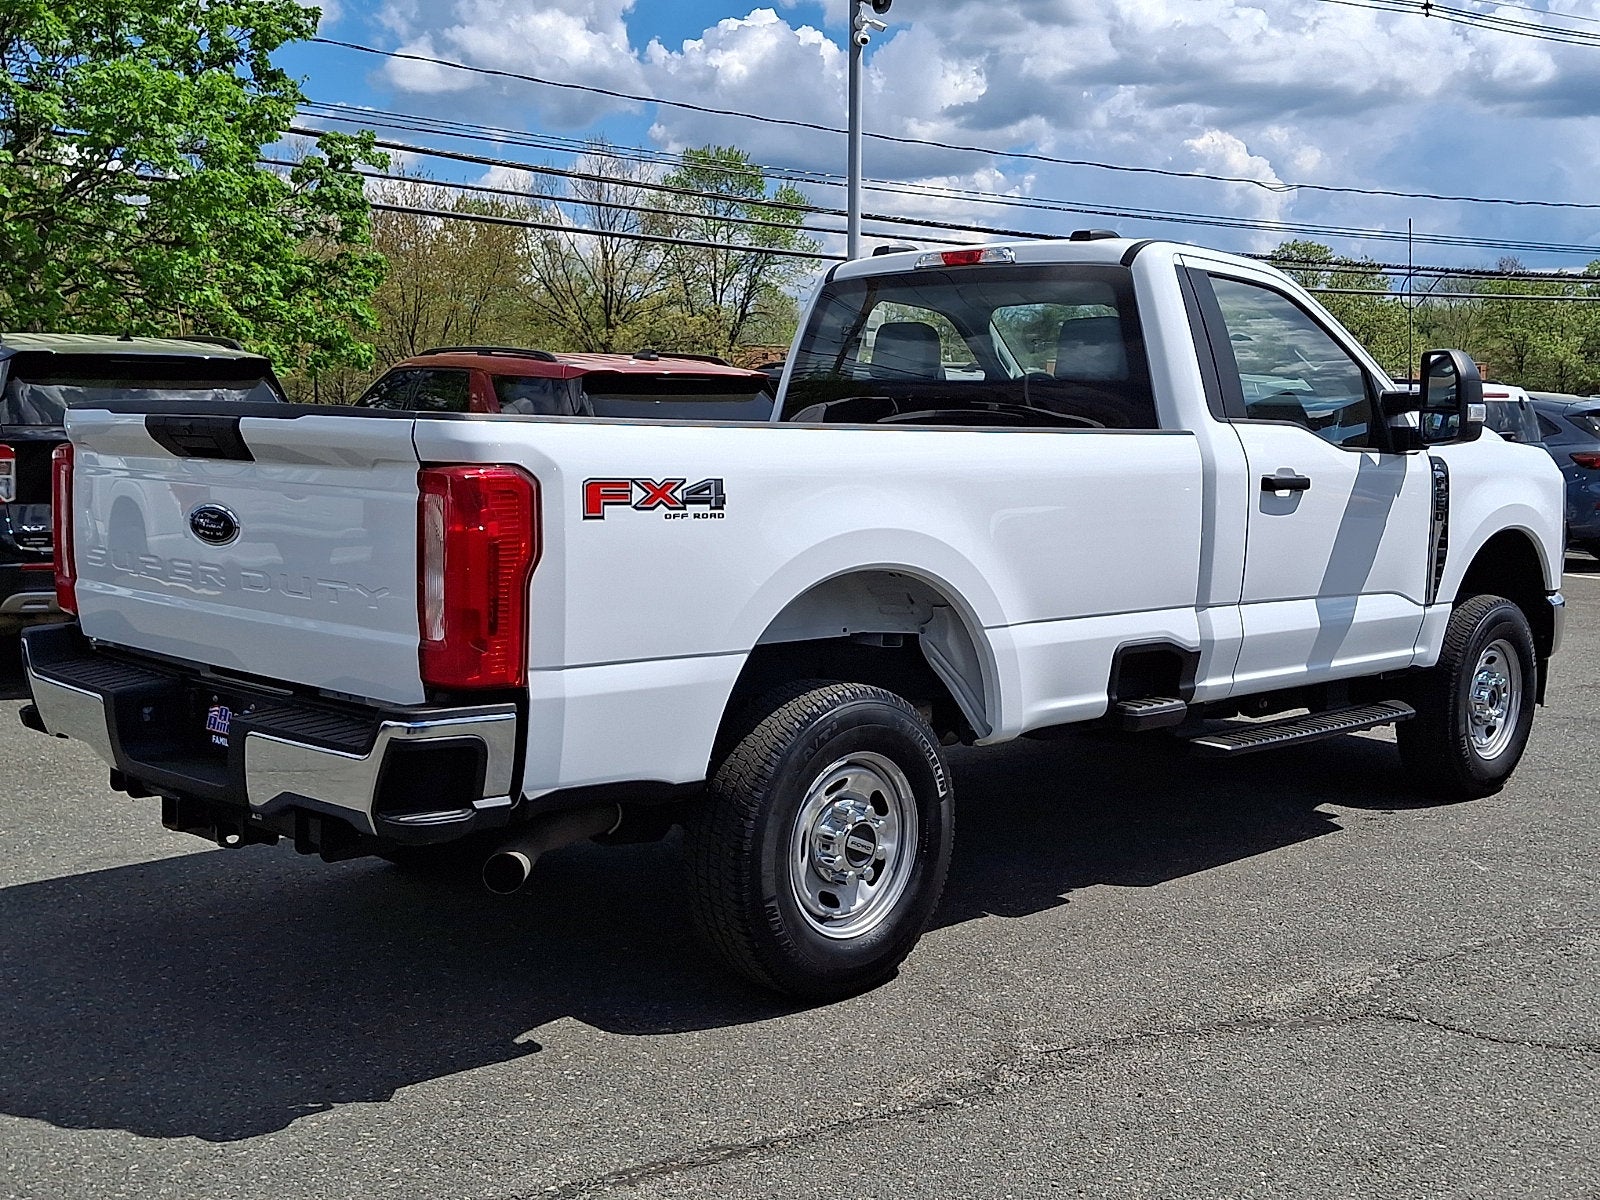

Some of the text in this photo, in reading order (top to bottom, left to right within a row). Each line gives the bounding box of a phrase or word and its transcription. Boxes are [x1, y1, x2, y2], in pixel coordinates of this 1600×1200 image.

[583, 478, 726, 520] FX4
[693, 512, 725, 520] ROAD
[86, 546, 390, 610] SUPER DUTY
[904, 720, 947, 796] MICHELIN
[850, 840, 872, 851] FORD
